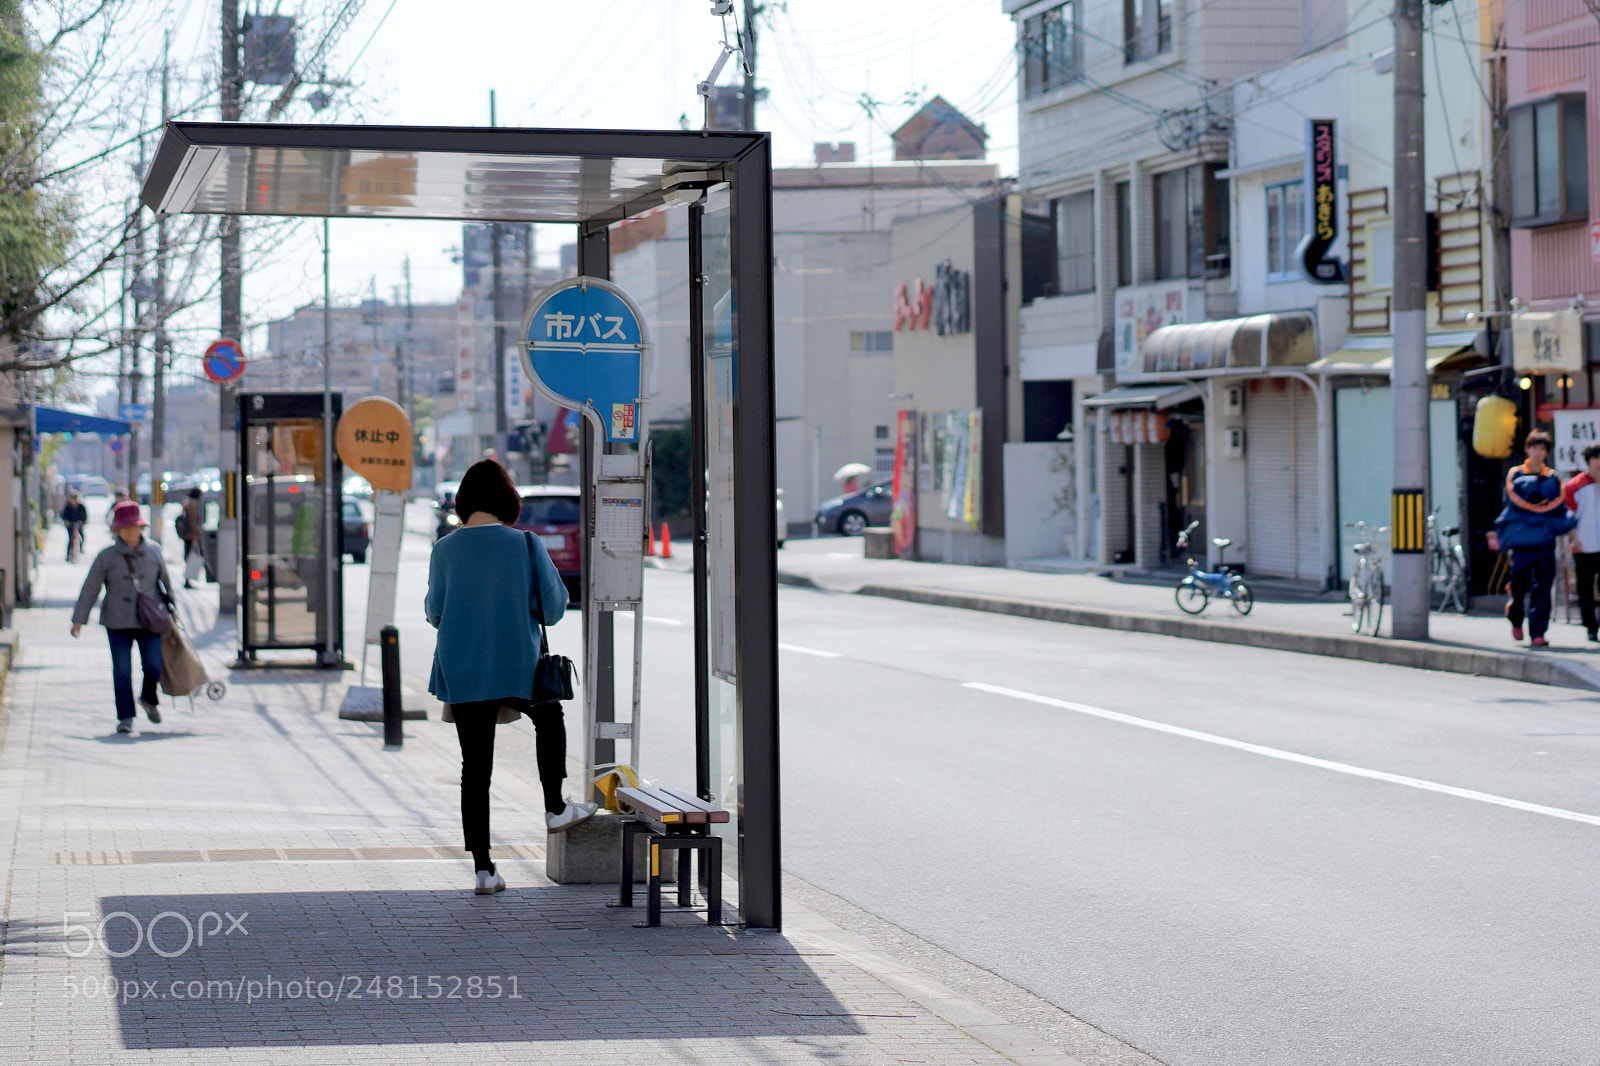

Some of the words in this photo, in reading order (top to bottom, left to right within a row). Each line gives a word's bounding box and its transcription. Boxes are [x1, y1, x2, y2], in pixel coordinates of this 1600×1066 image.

[544, 311, 627, 340] 市バス
[354, 428, 400, 445] 休止中
